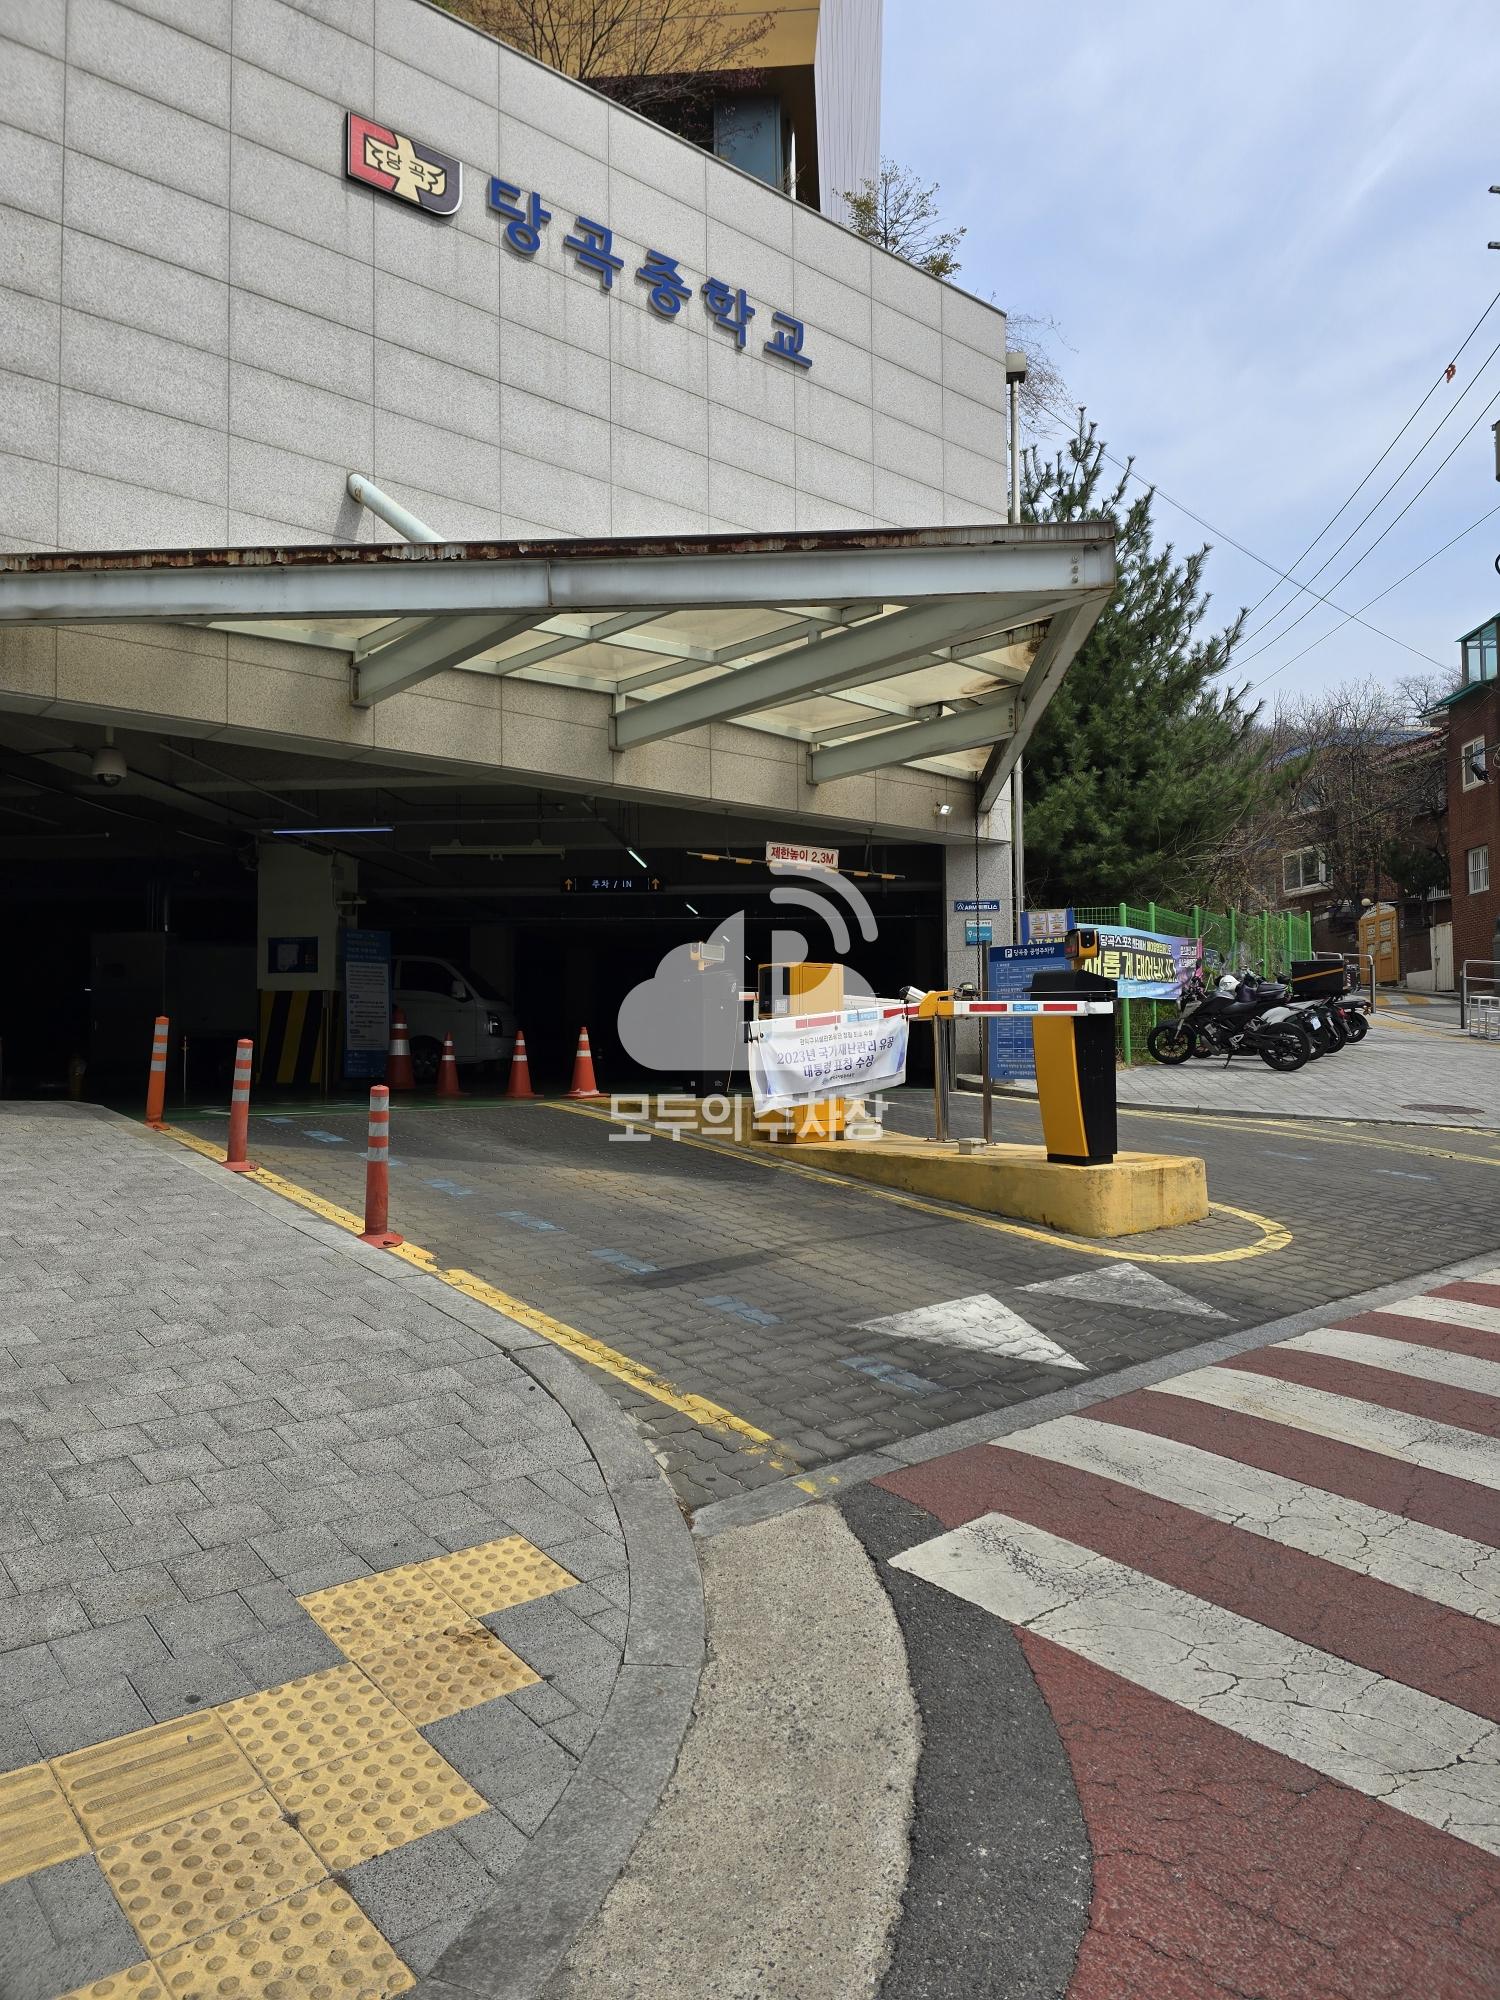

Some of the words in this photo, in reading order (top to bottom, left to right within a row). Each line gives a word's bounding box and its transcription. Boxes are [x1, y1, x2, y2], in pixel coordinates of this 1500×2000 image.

[488, 176, 813, 369] 당곡중학교
[771, 846, 808, 862] 제한높이
[812, 851, 835, 865] 2.3M
[592, 879, 609, 889] 주차
[622, 880, 632, 888] IN
[776, 1051, 816, 1065] 2023년
[818, 1040, 877, 1059] 국가재난관리
[879, 1036, 895, 1050] 유공
[803, 1060, 832, 1078] 대통령
[833, 1057, 852, 1071] 표창
[855, 1055, 875, 1068] 수상
